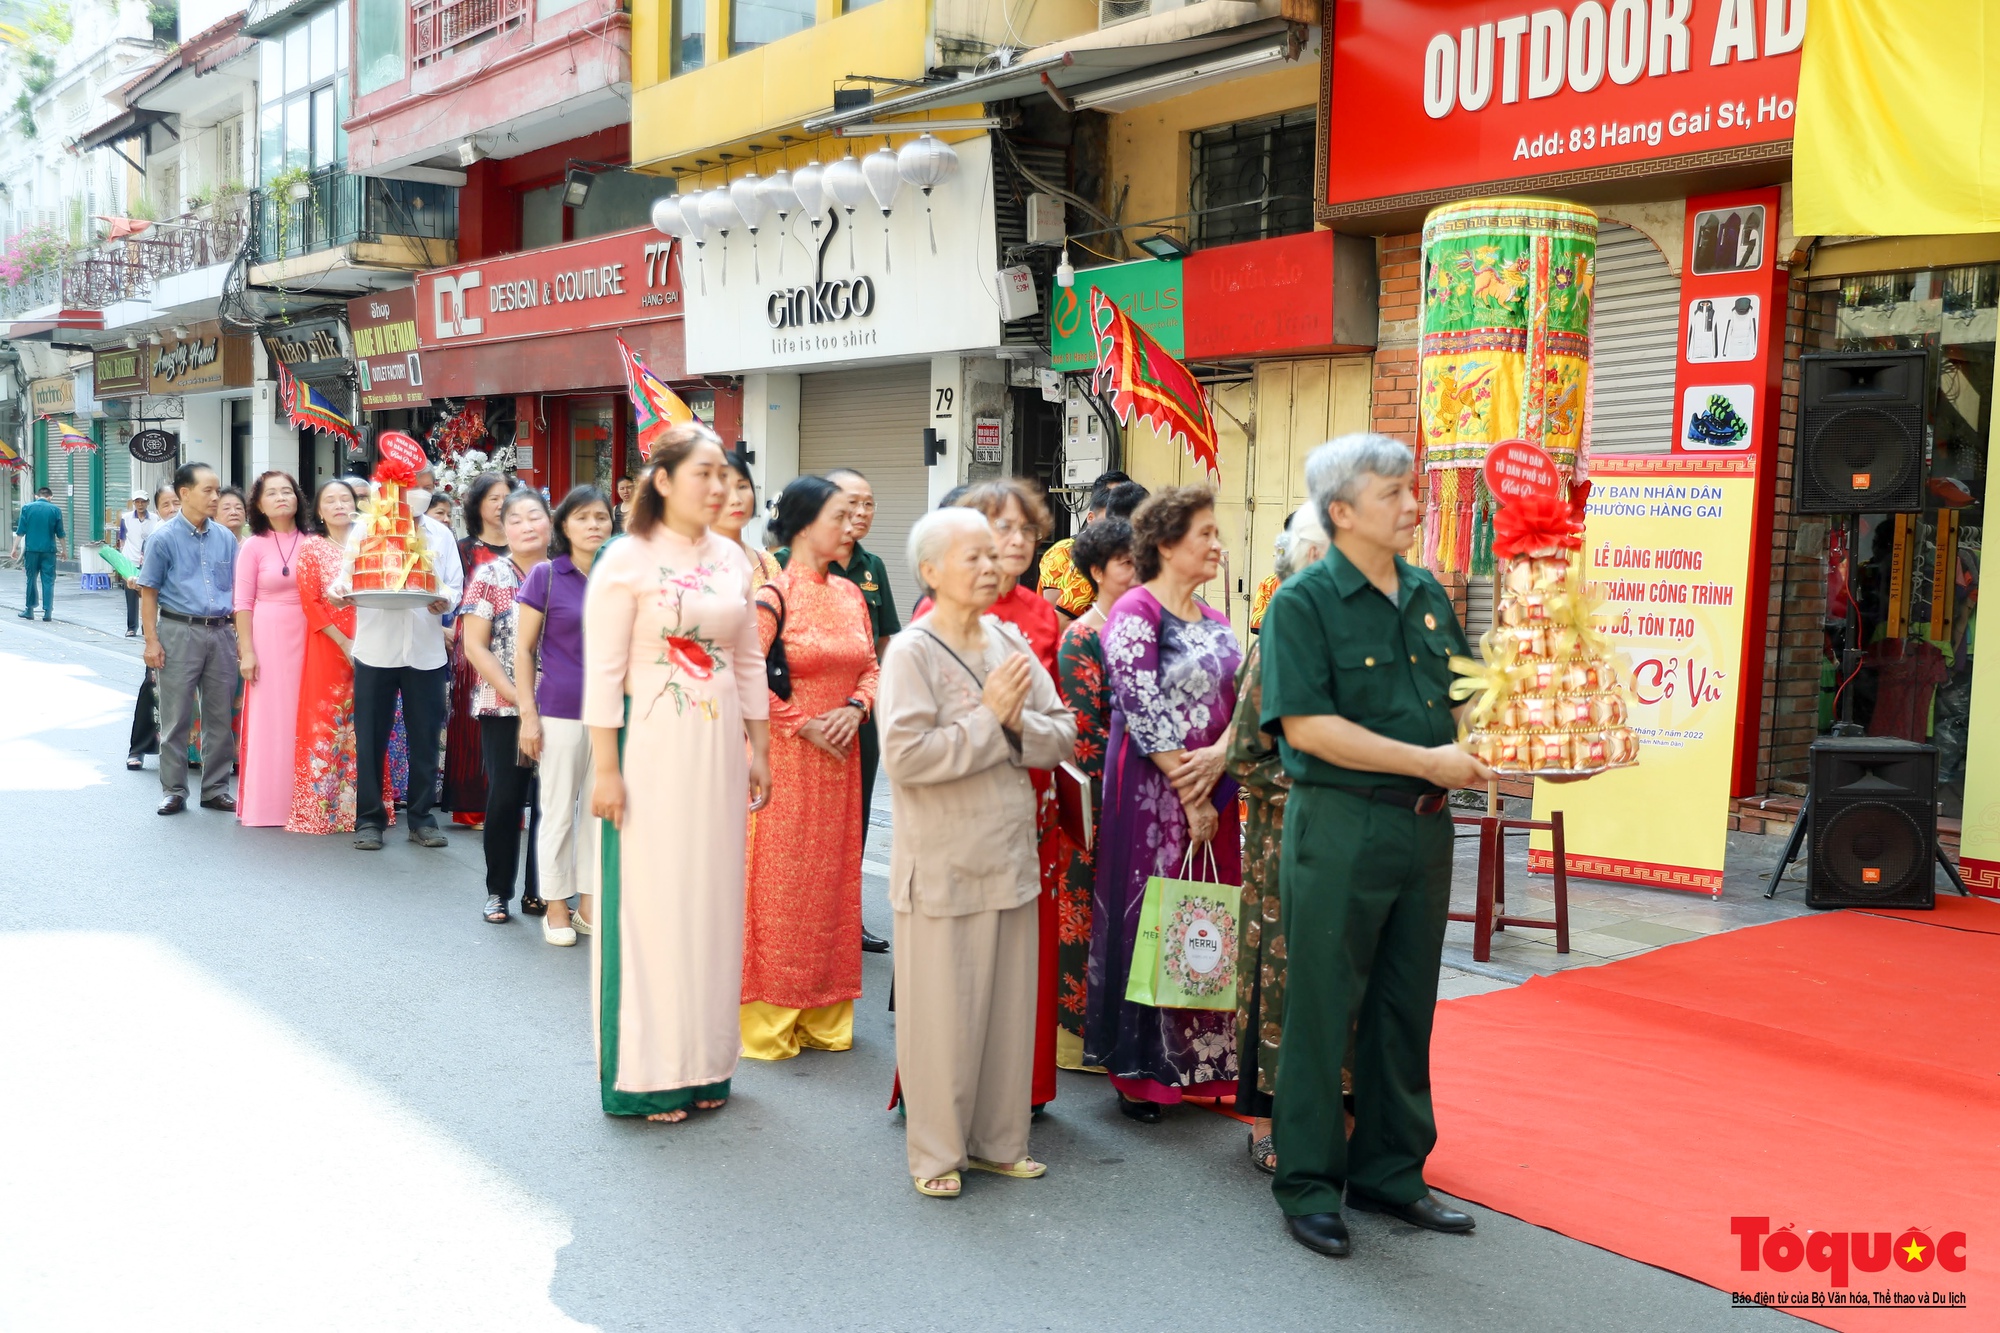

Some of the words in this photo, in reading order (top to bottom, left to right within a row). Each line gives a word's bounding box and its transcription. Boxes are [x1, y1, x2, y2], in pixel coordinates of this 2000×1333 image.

[1423, 0, 1691, 119] OUTDOOR
[1513, 137, 1564, 161] Add:
[1569, 127, 1596, 151] 83
[1600, 117, 1662, 147] Hang
[1668, 106, 1710, 136] Gai
[1718, 101, 1751, 130] St,
[1757, 97, 1797, 123] Ho
[644, 240, 672, 288] 77
[490, 279, 538, 313] DESIGN
[542, 282, 553, 306] &
[555, 263, 627, 303] COUTURE
[641, 293, 663, 307] HÀNG
[665, 291, 680, 304] GAI
[370, 302, 390, 320] Shop
[354, 327, 376, 358] MADE
[374, 325, 385, 356] IN
[383, 320, 418, 354] VIETNAM
[772, 338, 796, 355] life
[800, 336, 811, 351] is
[816, 336, 838, 350] too
[843, 329, 877, 348] shirt
[372, 366, 388, 382] OUTLET
[387, 363, 407, 381] FACTORY
[936, 387, 954, 411] 79
[1506, 464, 1520, 478] DÂN
[1508, 449, 1528, 464] NHÂN
[1529, 455, 1543, 468] DÂN
[1609, 486, 1639, 498] BAN
[1644, 485, 1686, 499] NHÂN
[1690, 485, 1722, 500] DÂN
[1585, 502, 1646, 516] PHƯỜNG
[1650, 503, 1692, 517] HÀNG
[1696, 505, 1722, 518] GAI
[1594, 542, 1610, 567] LỄ
[1613, 545, 1651, 569] DÂNG
[1654, 548, 1703, 570] HƯƠNG
[1649, 580, 1687, 603] CÔNG
[1691, 581, 1734, 606] TRÌNH
[1638, 613, 1665, 636] TÔN
[1668, 617, 1695, 641] TẠO
[1629, 657, 1678, 705] Cổ
[1687, 658, 1727, 708] Vũ
[1634, 727, 1656, 737] tháng
[1664, 729, 1682, 737] năm
[1683, 730, 1704, 739] 2022
